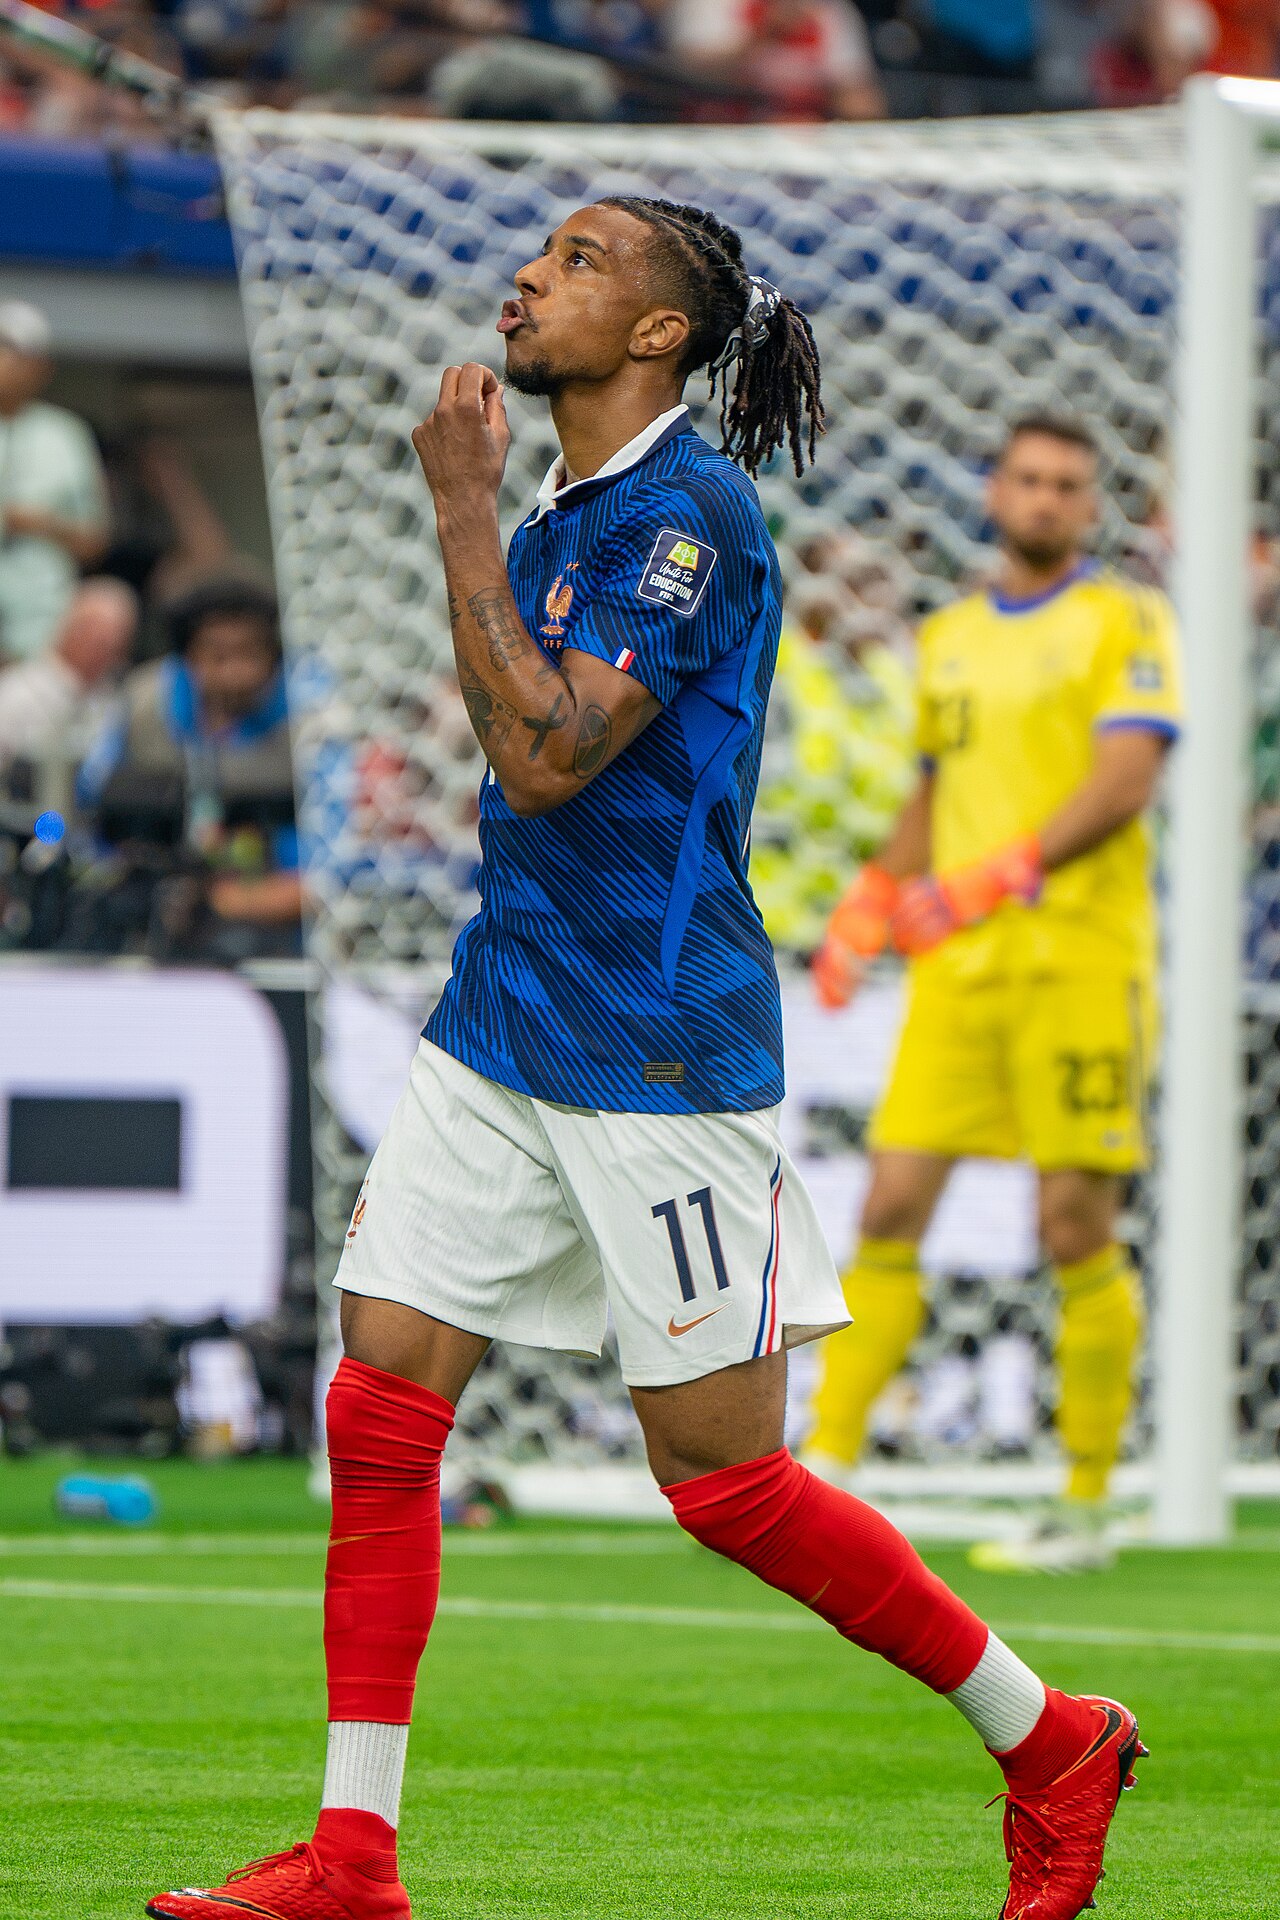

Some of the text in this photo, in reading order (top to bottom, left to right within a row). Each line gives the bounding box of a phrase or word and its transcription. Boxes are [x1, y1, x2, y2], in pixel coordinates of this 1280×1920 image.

[659, 562, 693, 583] Unite For
[649, 573, 693, 601] EDUCATION
[659, 590, 674, 602] FIFA
[543, 639, 562, 649] FFF
[651, 1186, 730, 1303] 11
